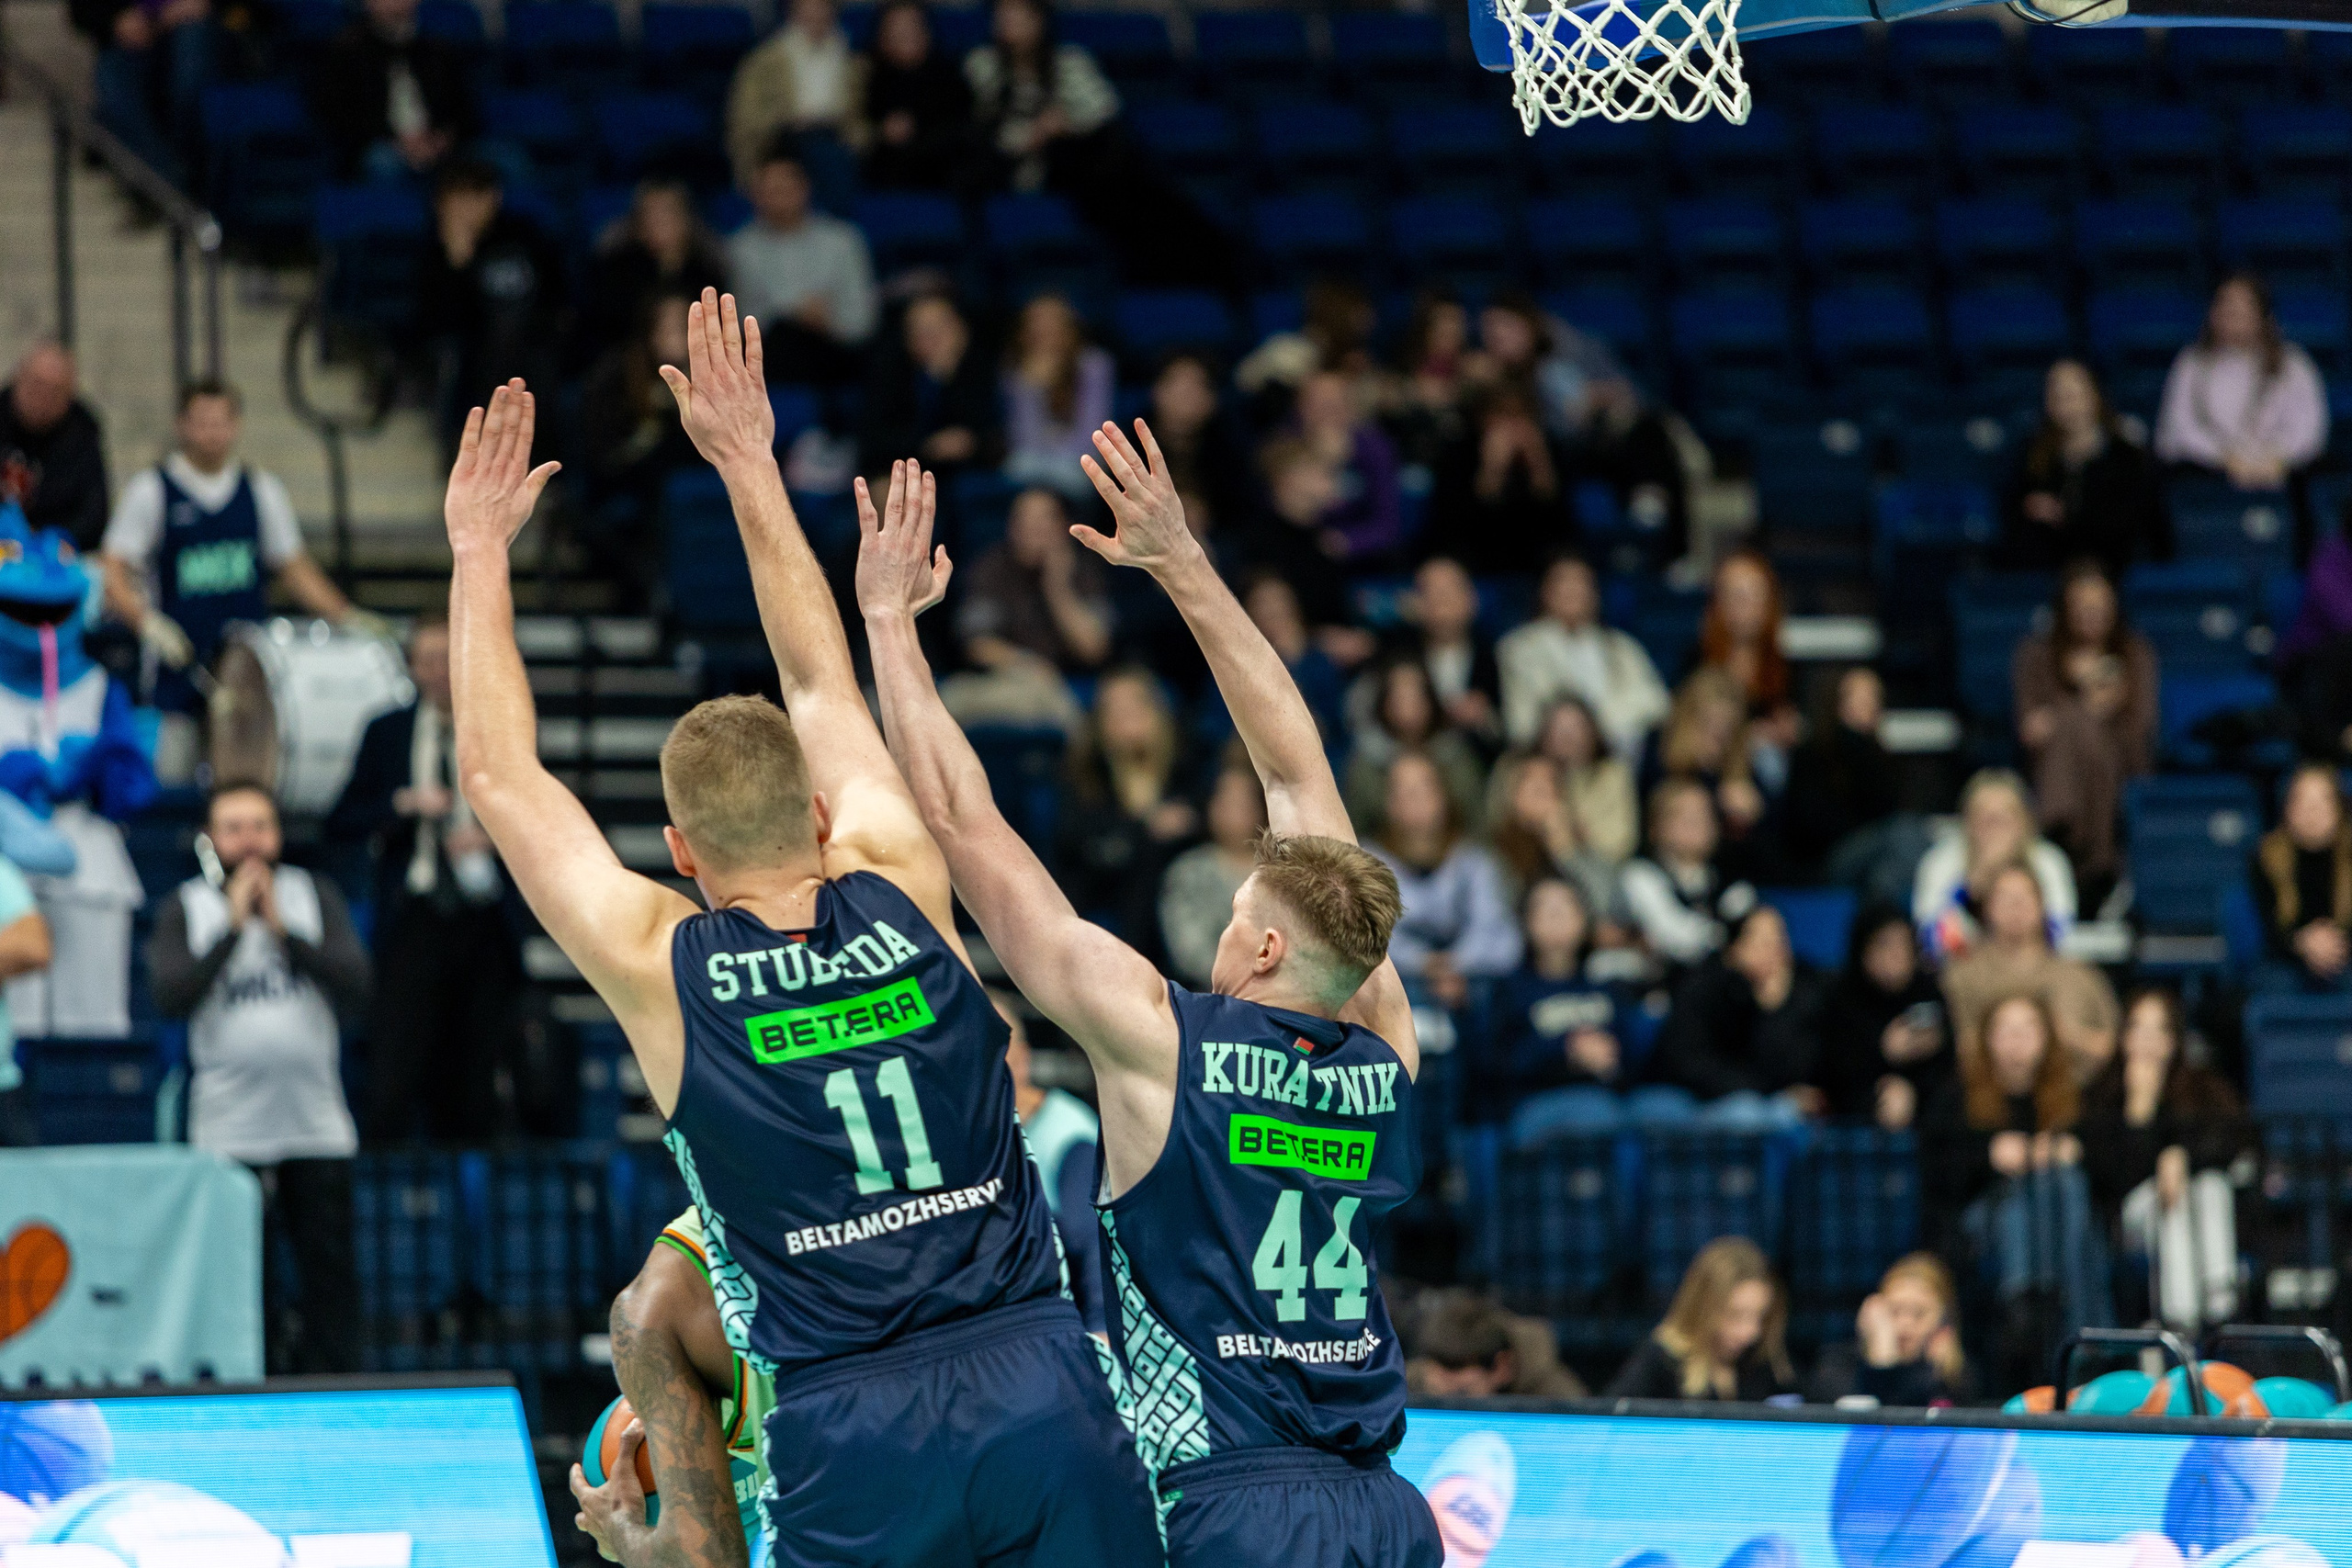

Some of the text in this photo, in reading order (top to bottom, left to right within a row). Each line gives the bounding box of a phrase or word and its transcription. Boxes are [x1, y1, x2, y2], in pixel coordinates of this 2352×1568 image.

[823, 1055, 944, 1195] 11
[1202, 1042, 1399, 1116] KURATNIK
[1239, 1126, 1365, 1169] BETERA
[1251, 1190, 1368, 1323] 44
